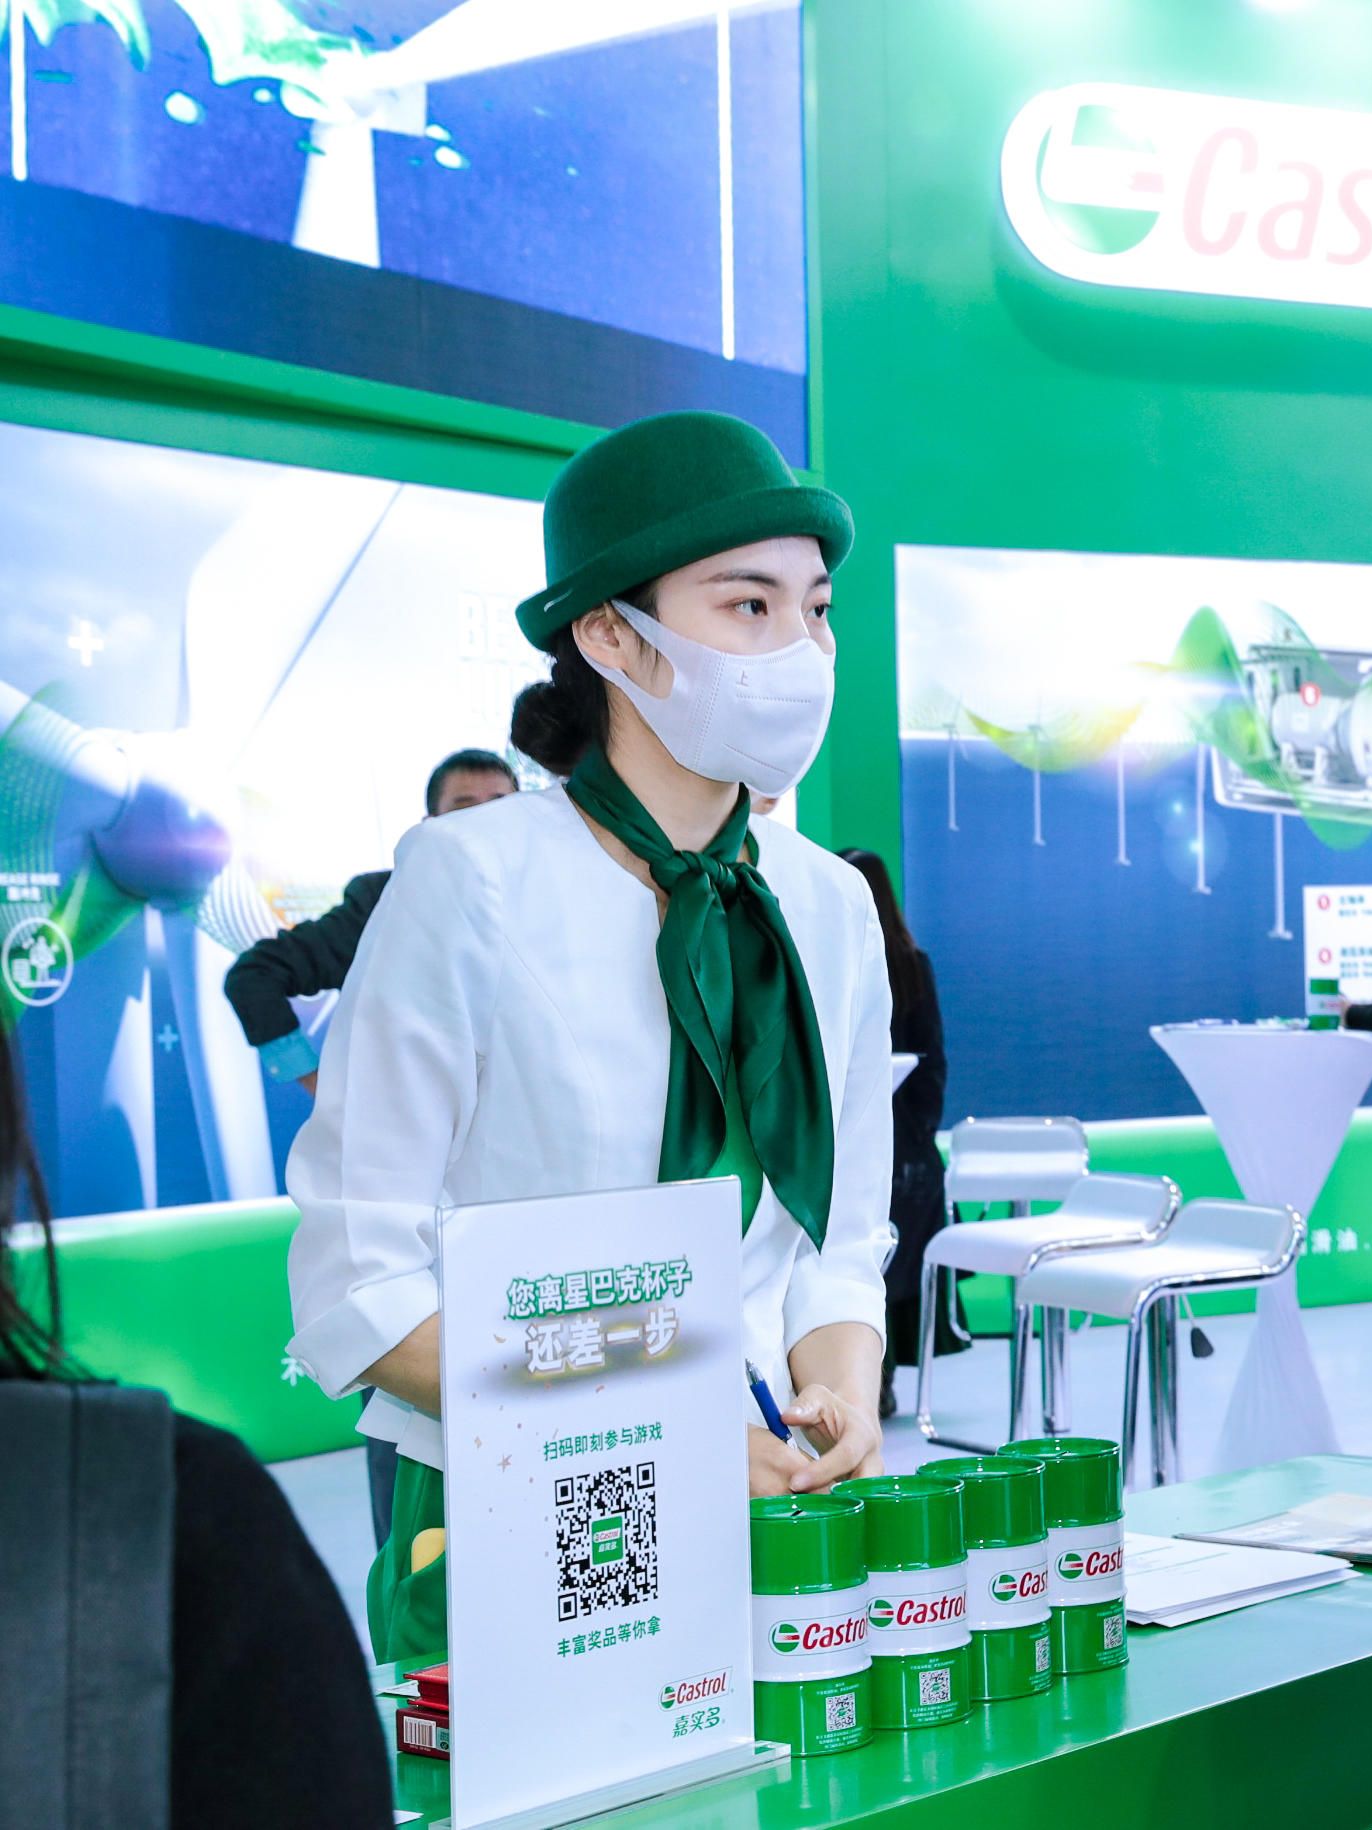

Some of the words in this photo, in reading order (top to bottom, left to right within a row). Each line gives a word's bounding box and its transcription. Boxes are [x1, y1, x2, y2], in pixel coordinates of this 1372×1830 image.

[507, 1260, 692, 1320] 您离星巴克杯子
[527, 1307, 679, 1373] 还差一步
[544, 1421, 663, 1461] 扫码即刻参与游戏
[897, 1590, 966, 1625] Castrol
[557, 1616, 661, 1657] 丰富奖品等你拿
[677, 1671, 726, 1704] Castrol
[673, 1706, 720, 1738] 嘉实多
